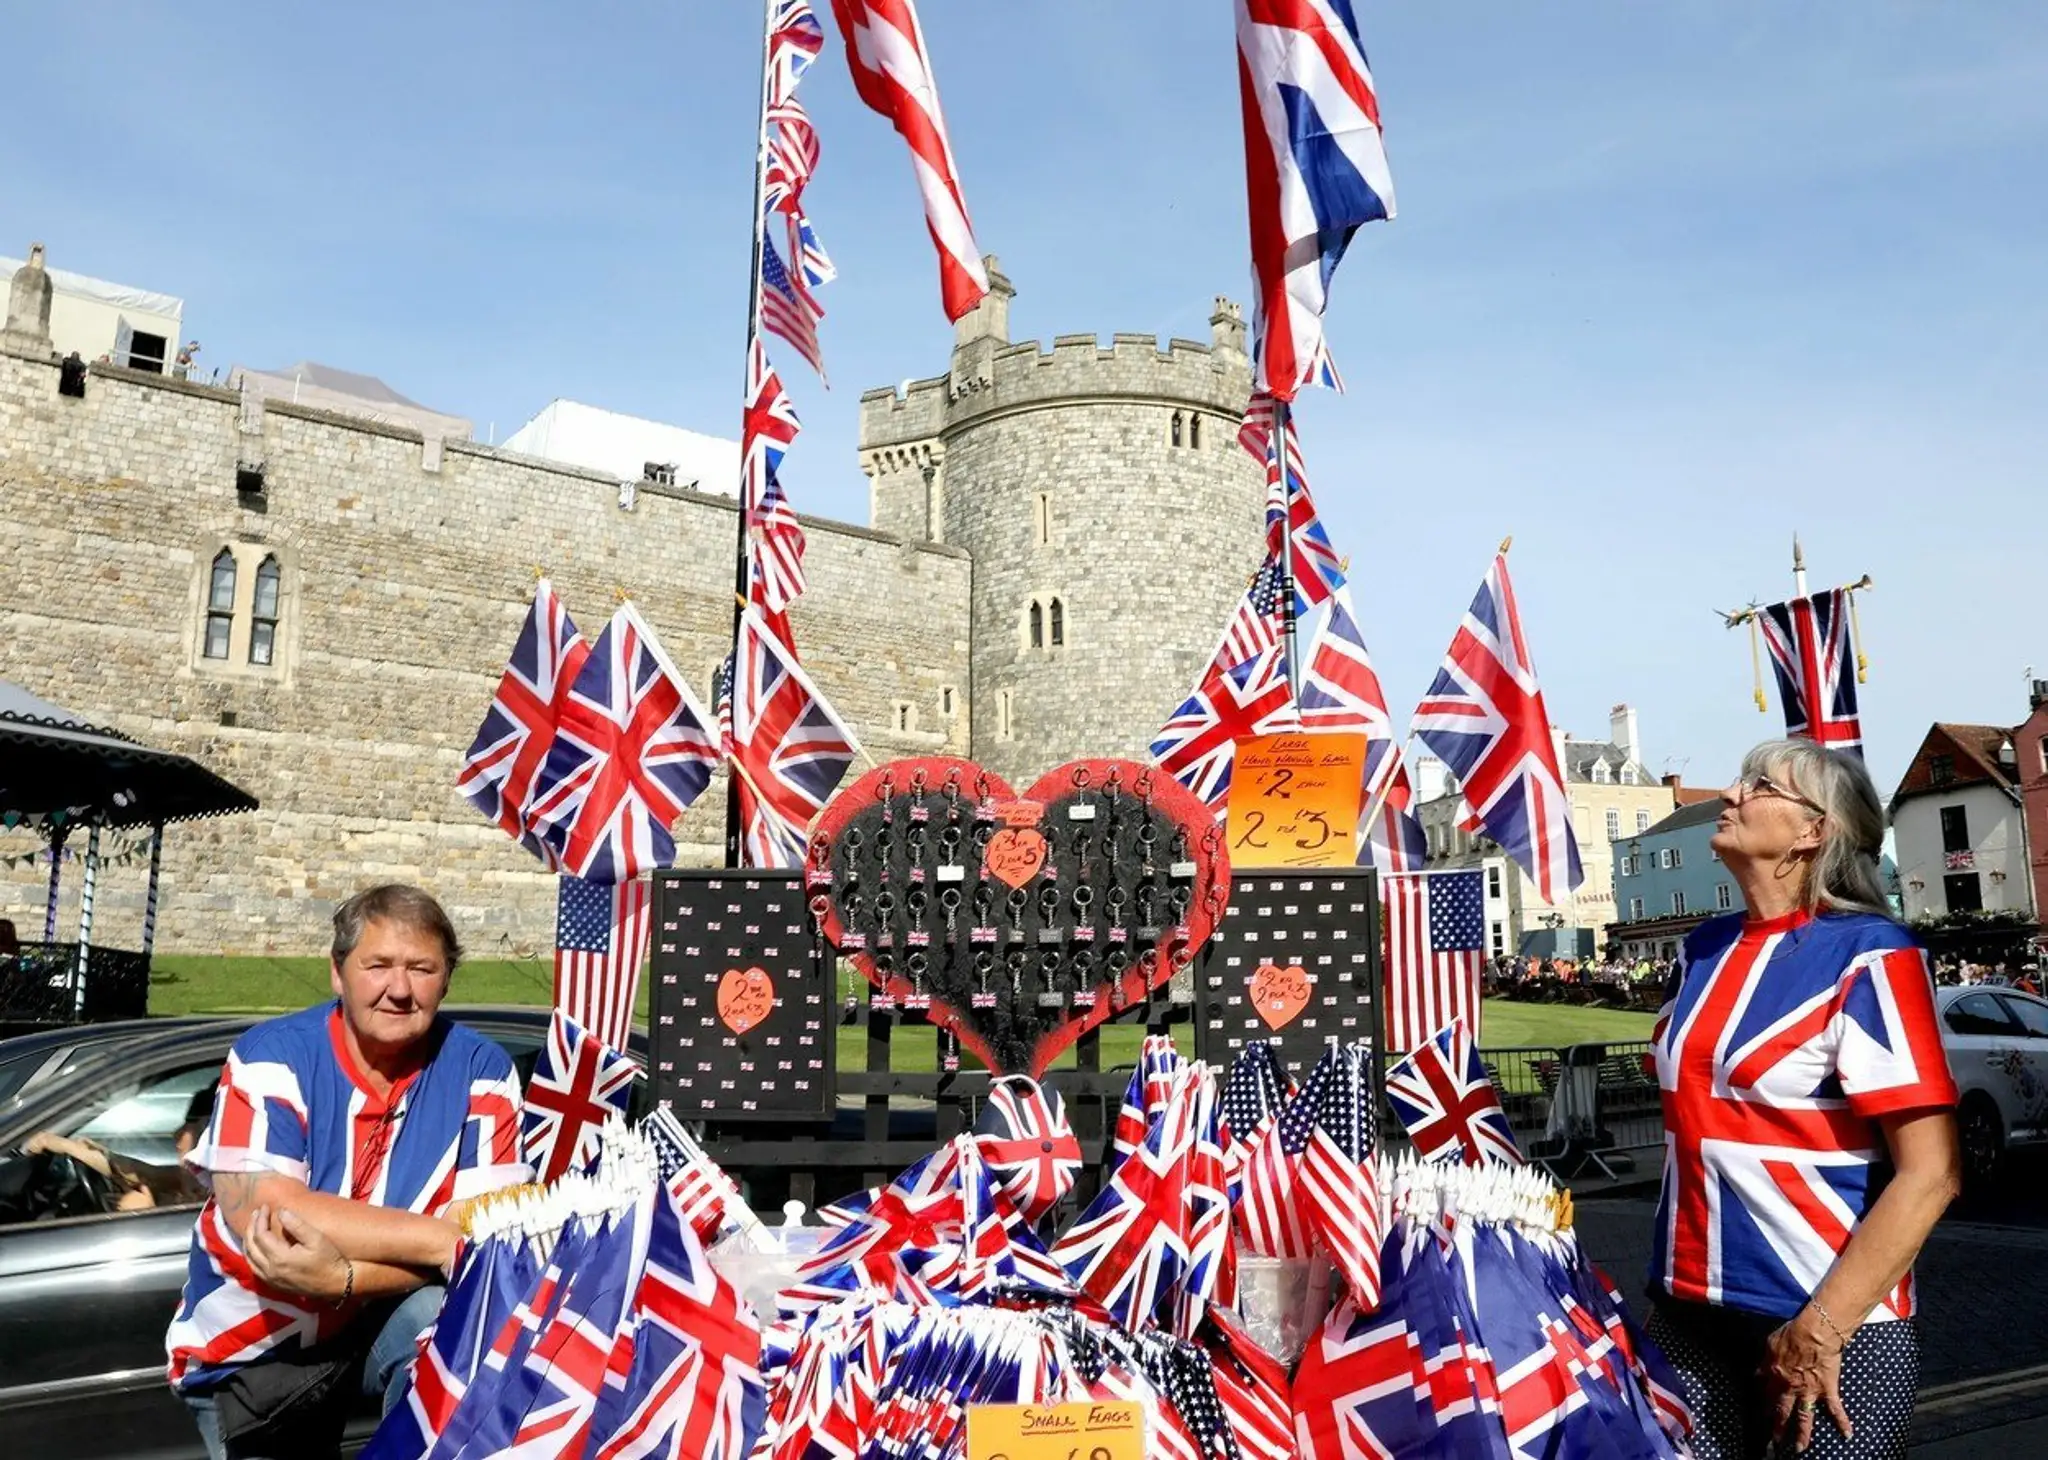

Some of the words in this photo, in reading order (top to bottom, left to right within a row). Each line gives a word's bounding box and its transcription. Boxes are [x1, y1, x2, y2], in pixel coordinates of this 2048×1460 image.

[1234, 811, 1269, 850] 2
[1021, 1409, 1076, 1429] SMALL
[1087, 1406, 1131, 1424] FLAGS
